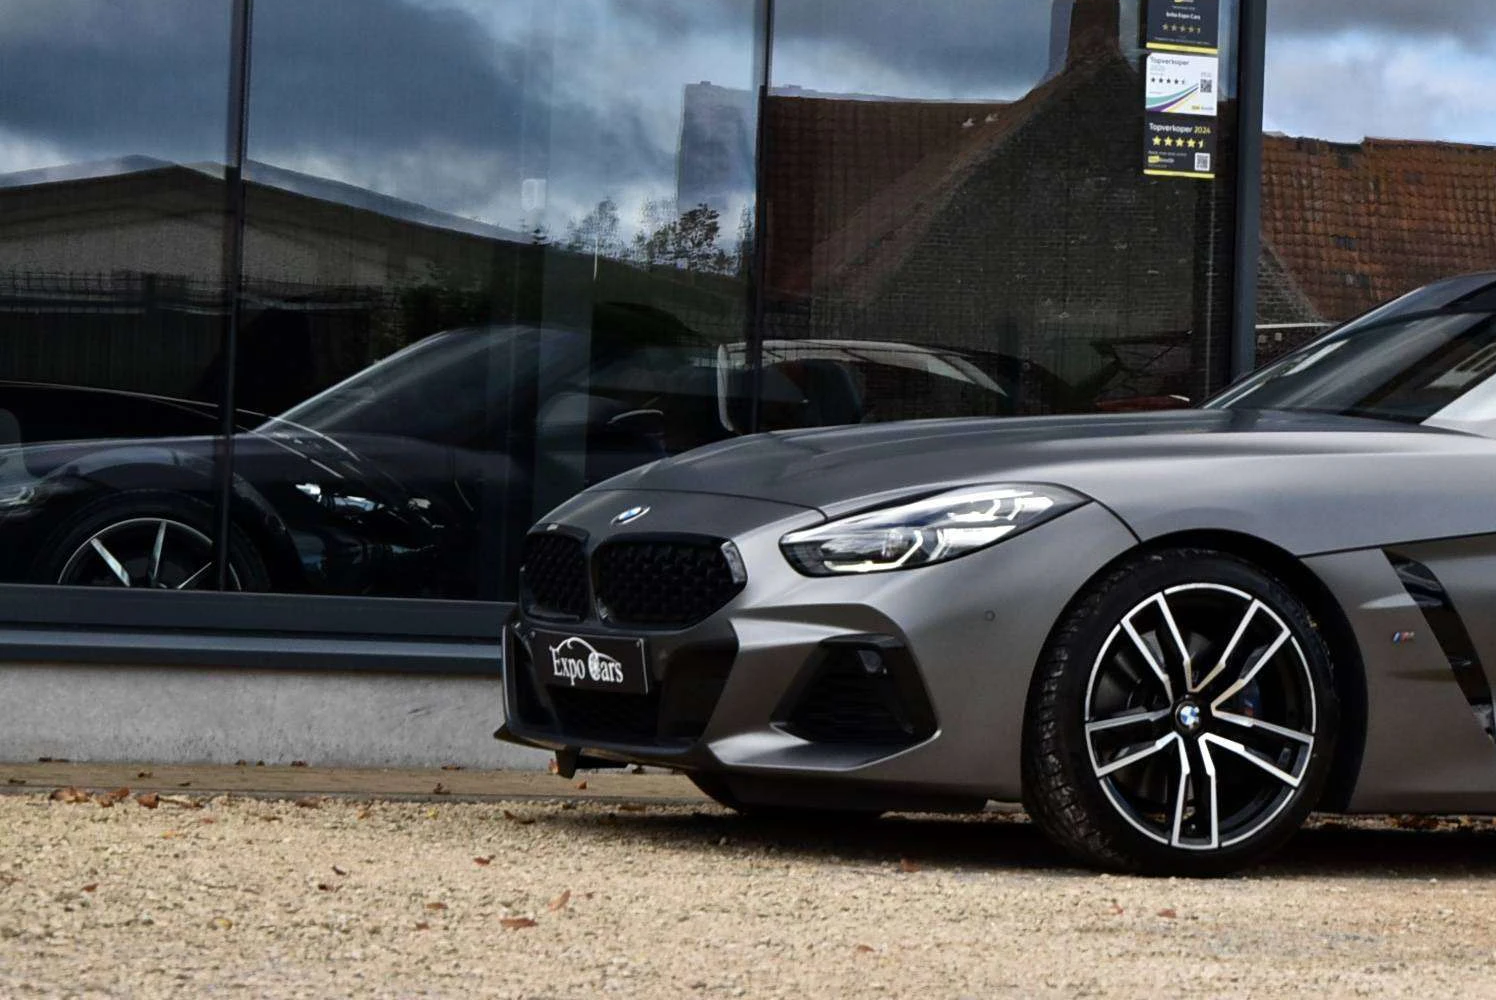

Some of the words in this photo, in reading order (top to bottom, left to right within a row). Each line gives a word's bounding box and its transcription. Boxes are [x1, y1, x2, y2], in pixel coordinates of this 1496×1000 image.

[1149, 56, 1189, 66] Topverkoper
[1149, 122, 1193, 134] Topverkoper
[1193, 125, 1212, 134] 2024
[550, 646, 586, 686] Expo
[588, 651, 624, 683] Cars
